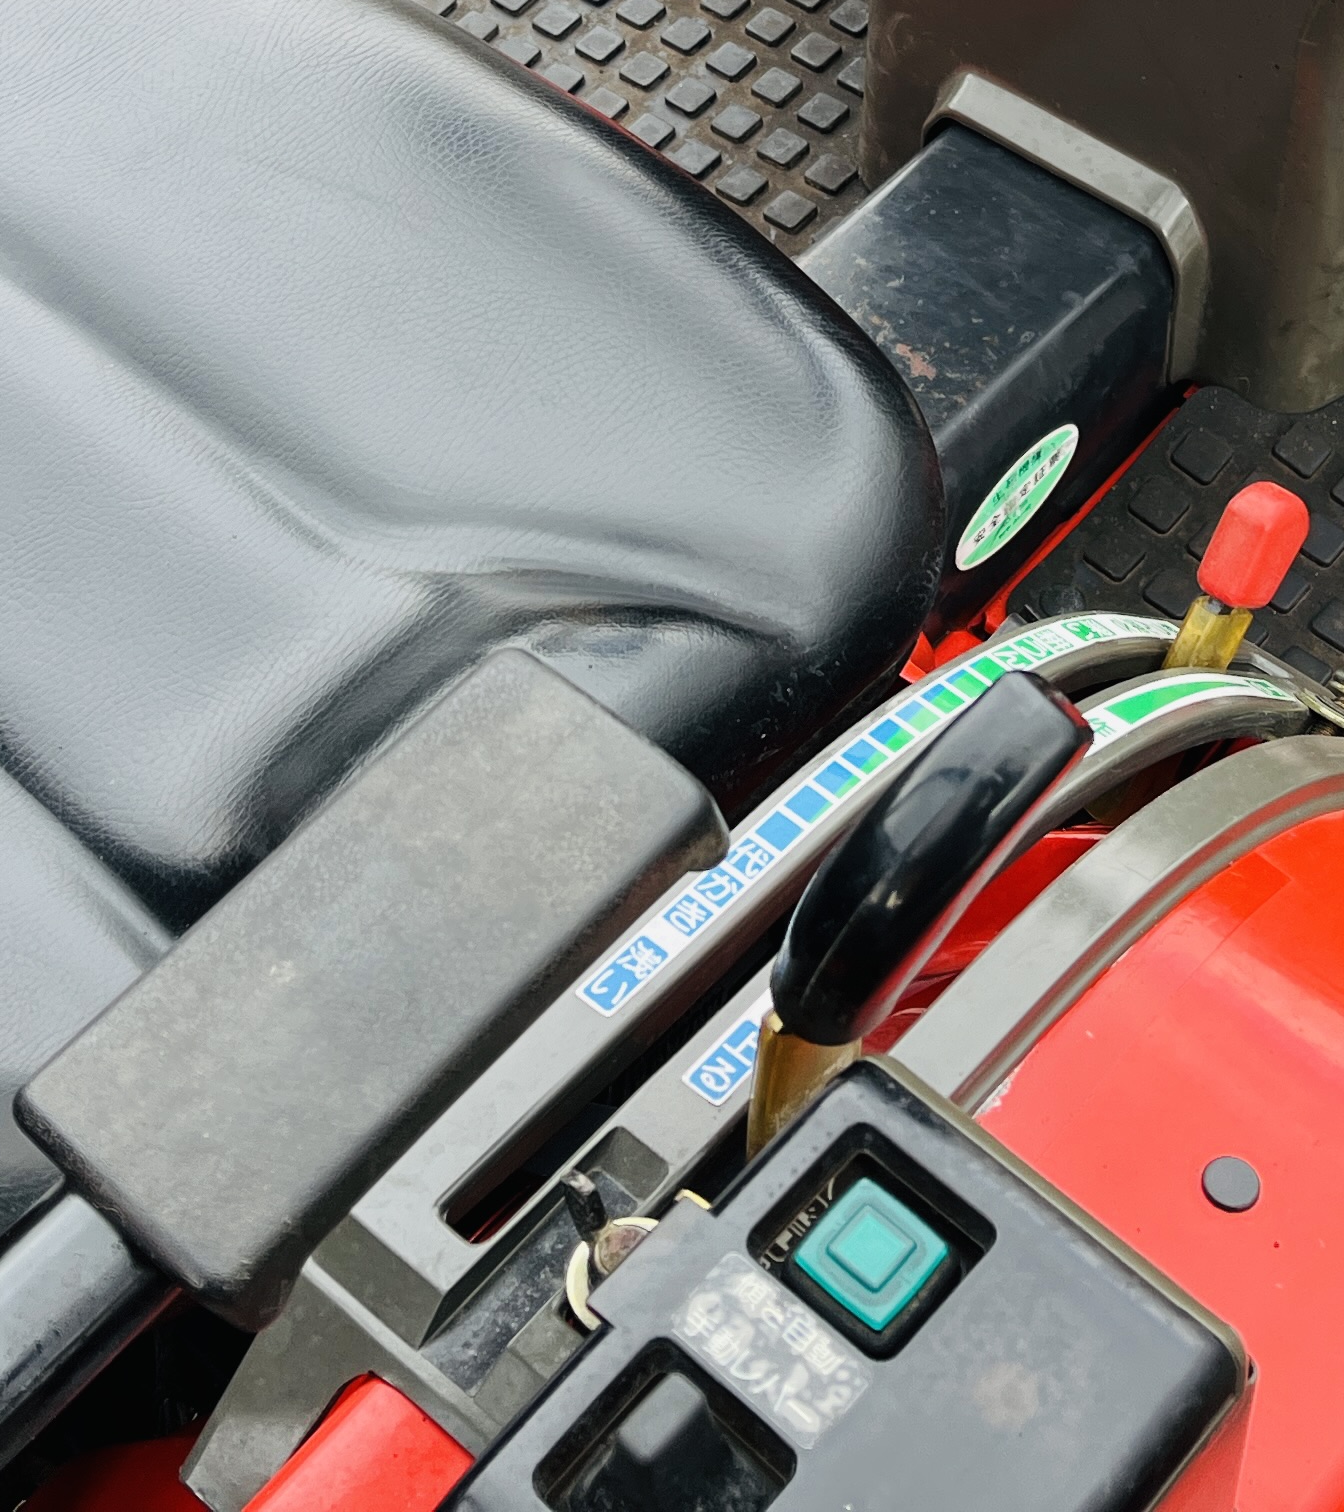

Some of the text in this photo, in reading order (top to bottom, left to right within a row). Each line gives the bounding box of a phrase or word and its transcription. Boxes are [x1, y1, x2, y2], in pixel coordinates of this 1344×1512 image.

[664, 837, 777, 937] 代かき
[587, 938, 665, 1009] 浅い
[698, 1029, 759, 1092] 上る
